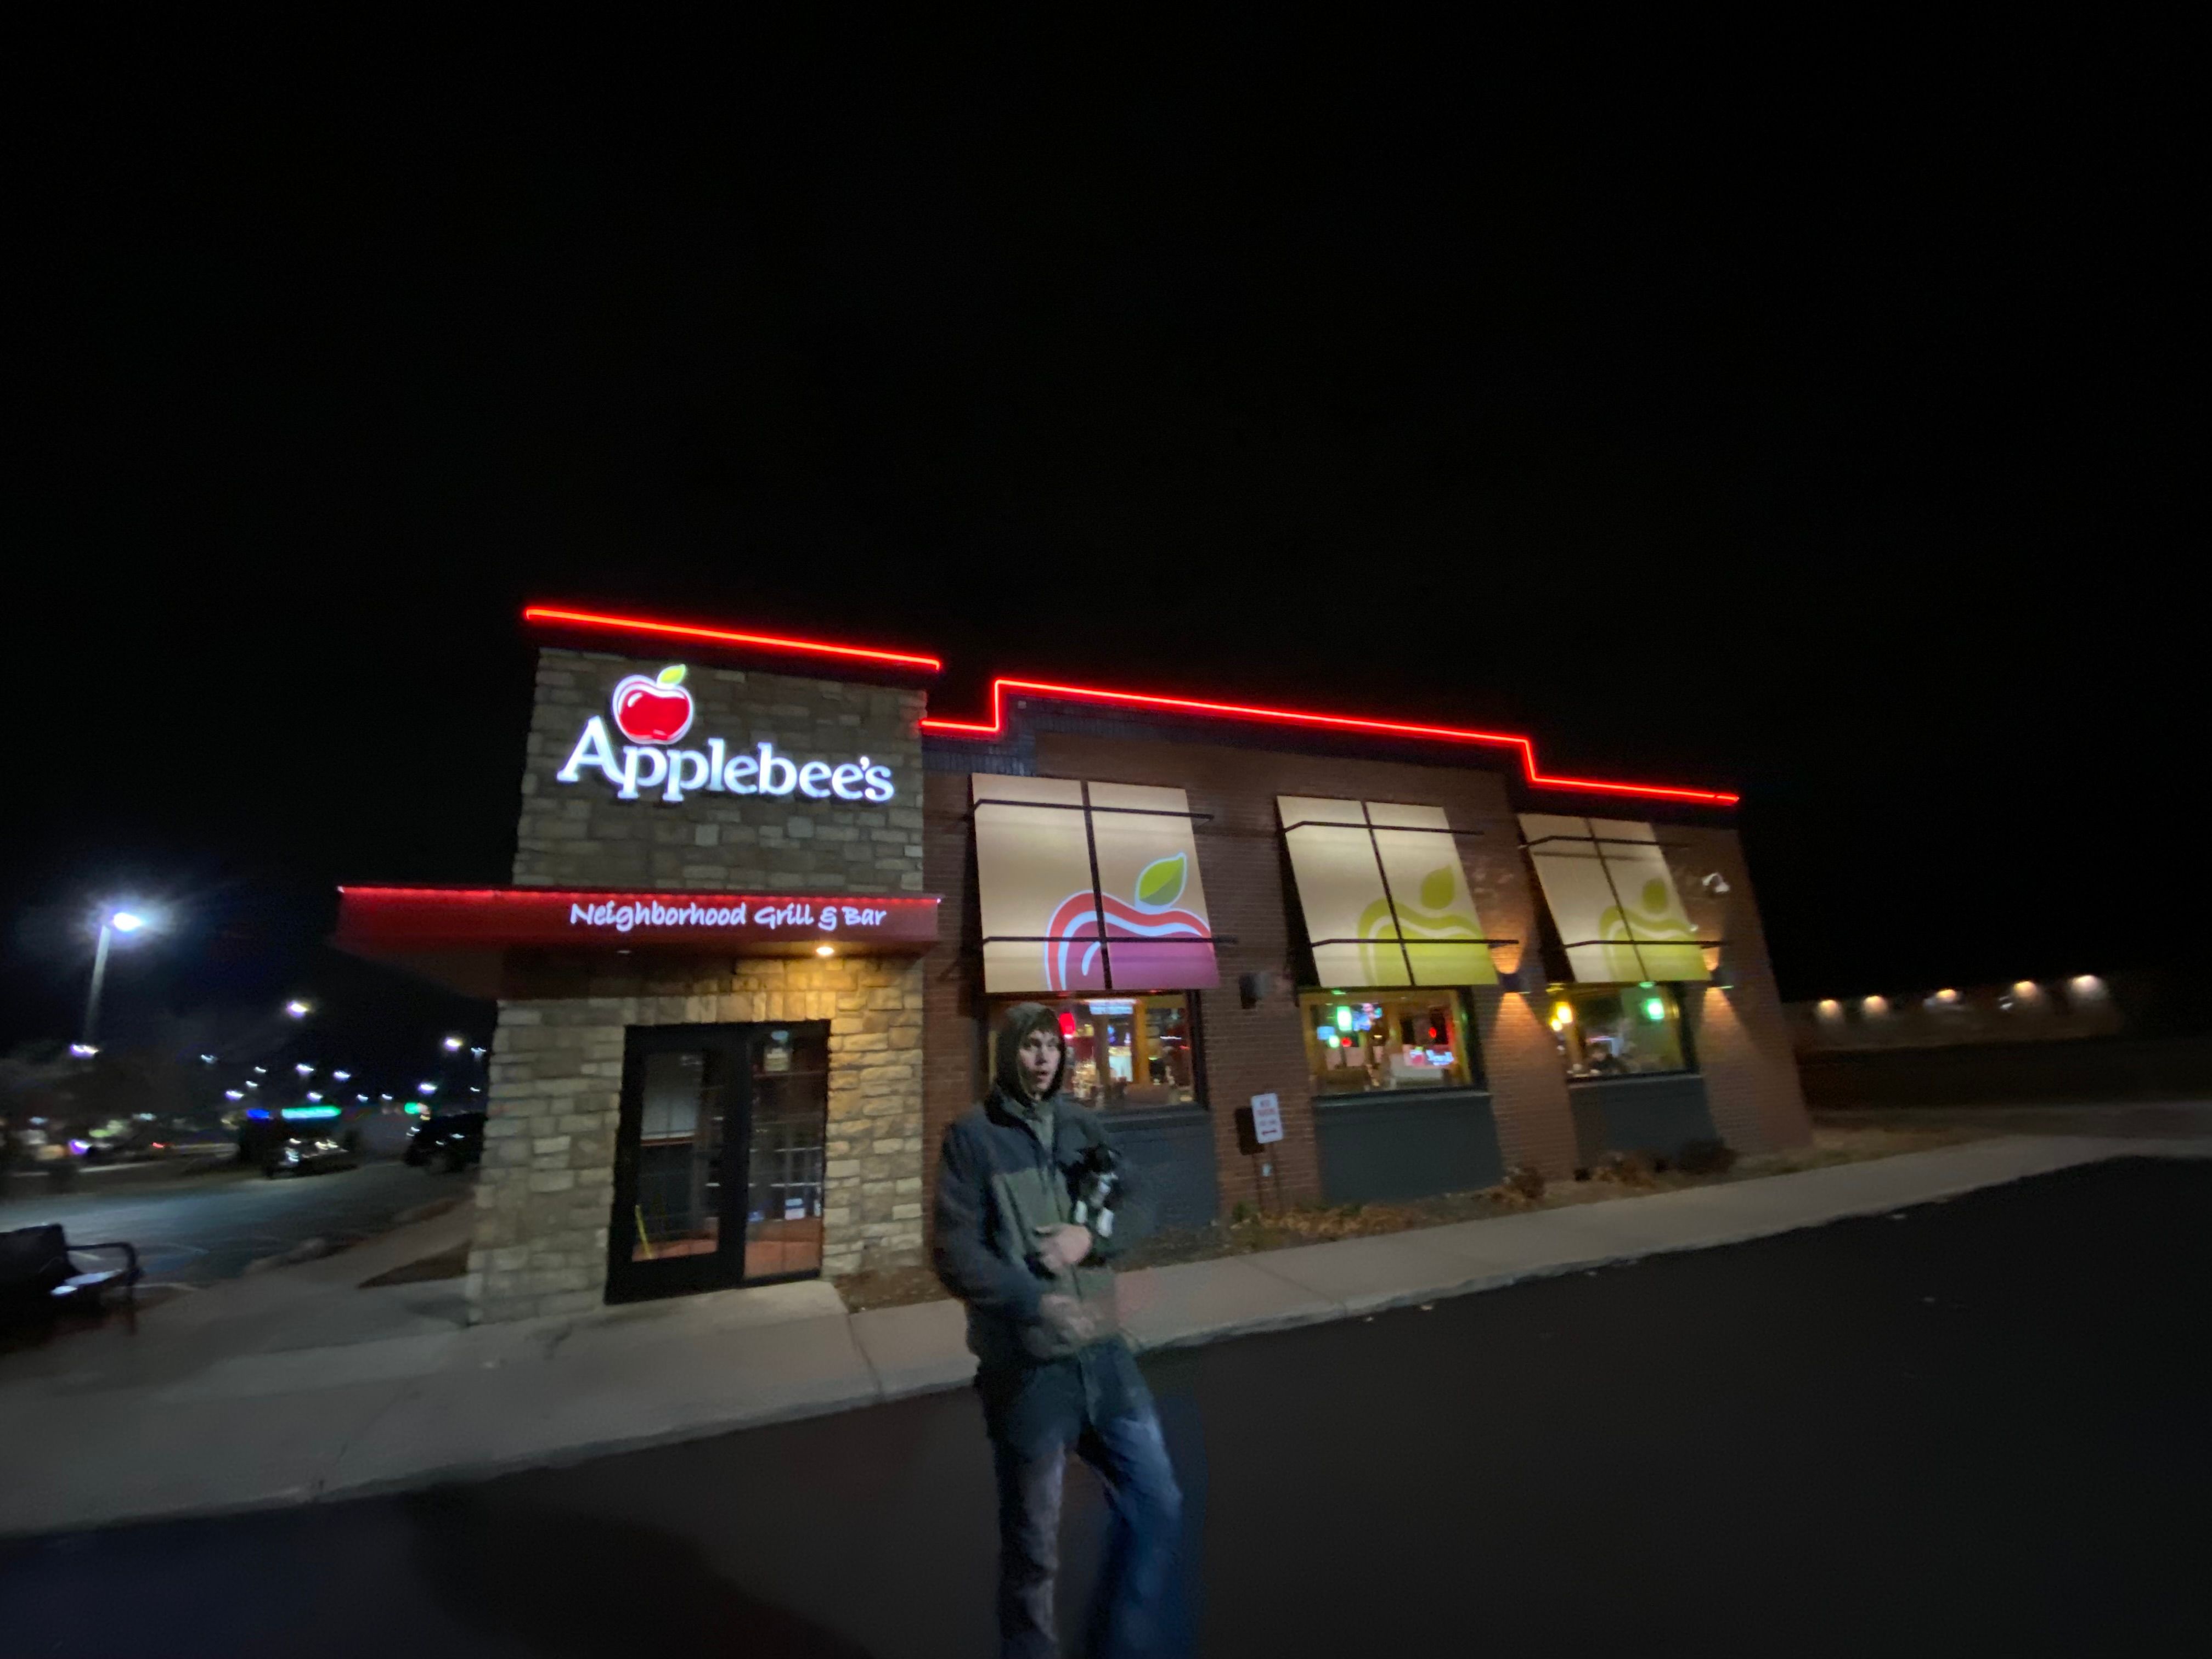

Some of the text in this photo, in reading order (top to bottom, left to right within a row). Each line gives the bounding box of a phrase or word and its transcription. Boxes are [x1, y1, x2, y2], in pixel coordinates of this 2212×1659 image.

[557, 716, 895, 802] Applebee's
[570, 900, 746, 932] Neighborhood
[754, 902, 814, 929] Grill
[842, 906, 887, 926] Bar
